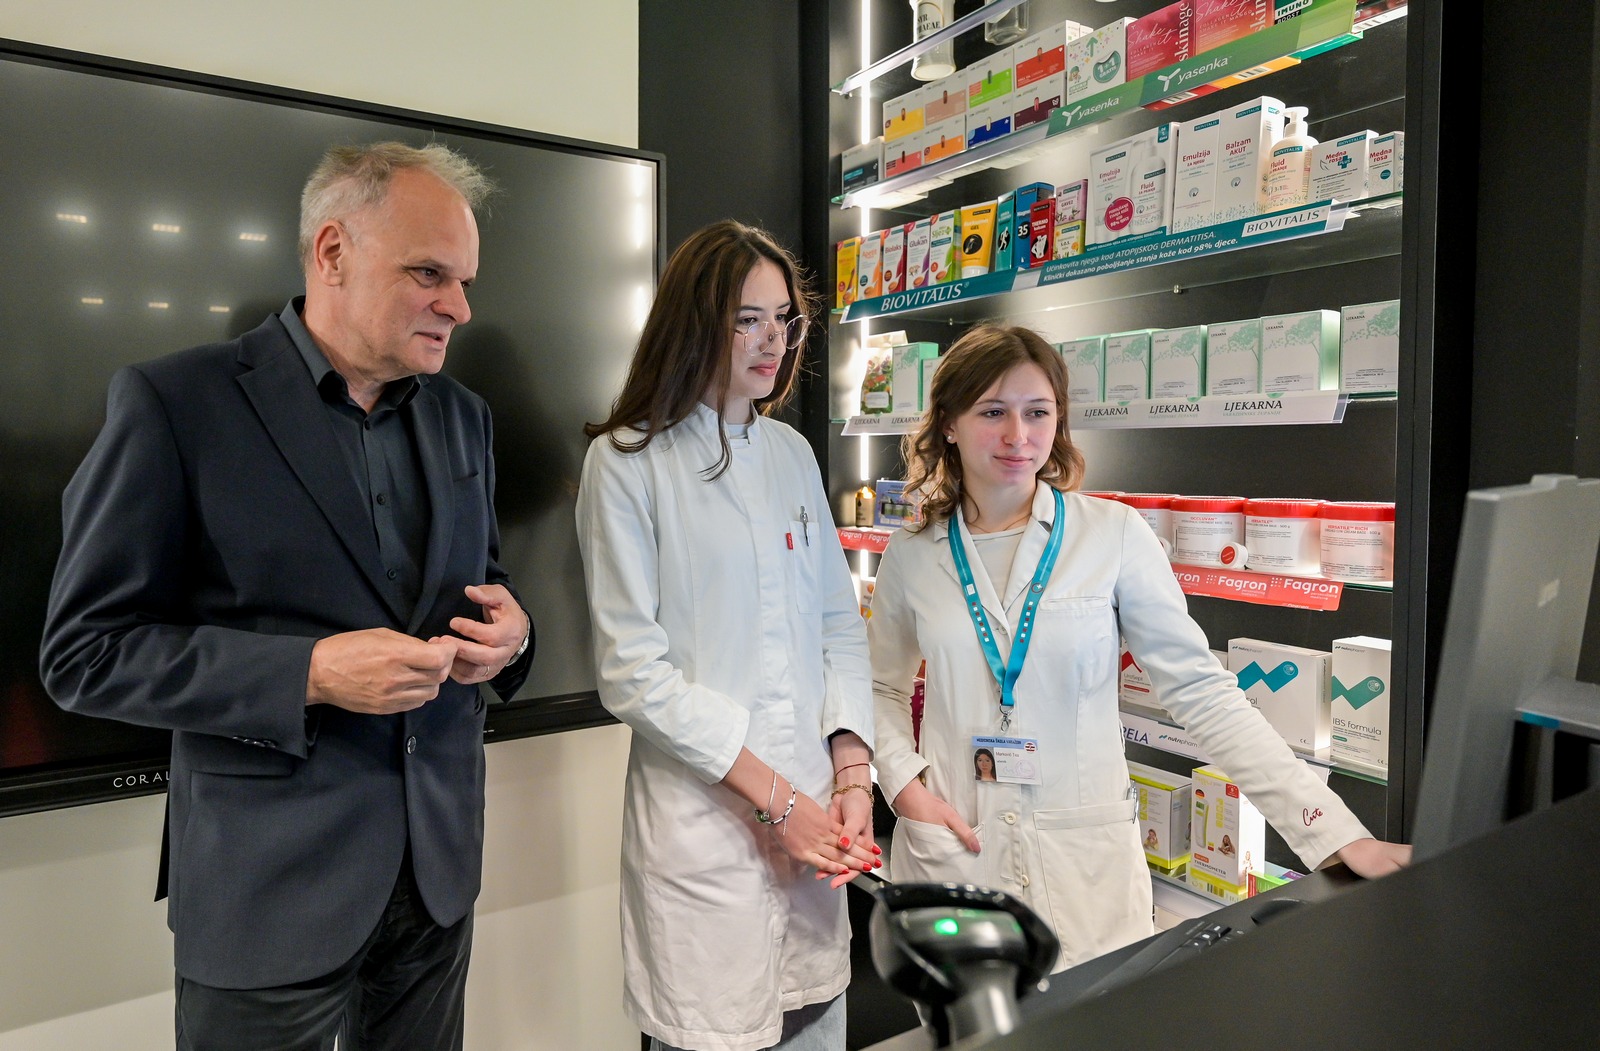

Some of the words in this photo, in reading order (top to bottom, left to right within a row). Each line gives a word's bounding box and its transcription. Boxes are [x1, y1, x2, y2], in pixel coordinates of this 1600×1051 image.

[1174, 3, 1193, 62] skinage
[1178, 57, 1228, 85] yasenka
[1078, 97, 1120, 121] yasenka
[1225, 138, 1252, 151] Balzam
[1229, 146, 1247, 156] AKUT
[1182, 149, 1211, 163] Emulzija
[1325, 150, 1347, 160] Medna
[1328, 156, 1342, 164] rosa
[1369, 148, 1392, 159] Medna
[1373, 154, 1388, 162] rosa
[1247, 210, 1319, 233] BIOVITALIS
[1018, 224, 1028, 237] 35
[909, 238, 928, 248] Glukan
[1046, 259, 1079, 272] Učinkovita
[1080, 257, 1099, 268] njega
[1100, 252, 1115, 263] kod
[1160, 231, 1217, 250] DERMATITISA.
[1043, 270, 1065, 282] Klinički
[1066, 265, 1096, 278] dokazano
[1096, 258, 1135, 273] poboljšanje
[1136, 254, 1157, 265] stanja
[1158, 248, 1177, 259] kože
[1177, 245, 1192, 255] kod
[1193, 242, 1213, 253] 98%
[1214, 238, 1238, 250] djece.
[881, 283, 963, 312] BIOVITALIS
[1150, 404, 1200, 414] LJEKARNA
[1224, 400, 1283, 411] LJEKARNA
[1084, 407, 1129, 418] LJEKARNA
[841, 530, 862, 540] Fagron
[1218, 575, 1267, 591] Fagron
[1284, 578, 1339, 595] Fagron
[1333, 717, 1346, 727] IBS
[1347, 720, 1382, 736] formula
[1168, 736, 1198, 748] nutripharm
[1194, 860, 1227, 876] THERMOMETER
